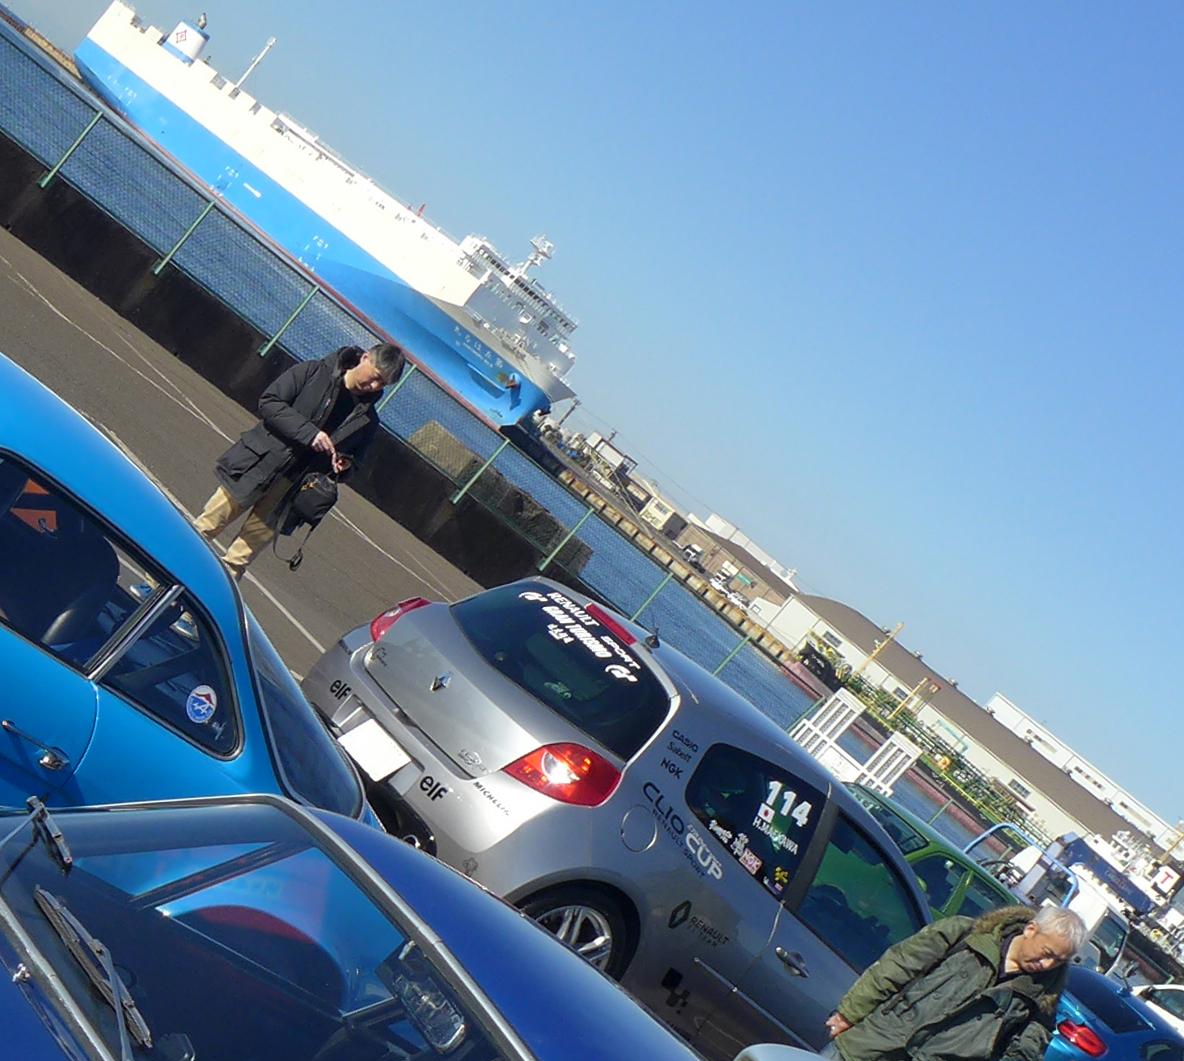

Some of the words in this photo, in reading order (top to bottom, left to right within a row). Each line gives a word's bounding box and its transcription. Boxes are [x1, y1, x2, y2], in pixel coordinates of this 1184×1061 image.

[546, 592, 600, 626] RENAULT
[600, 635, 641, 669] SPORT
[329, 680, 352, 700] elf
[672, 730, 699, 753] CASIO
[660, 757, 684, 779] NGK
[419, 775, 448, 801] elf
[766, 780, 812, 827] 114
[643, 781, 684, 835] CLIO
[686, 832, 723, 880] CUP
[689, 916, 729, 945] RENAULT
